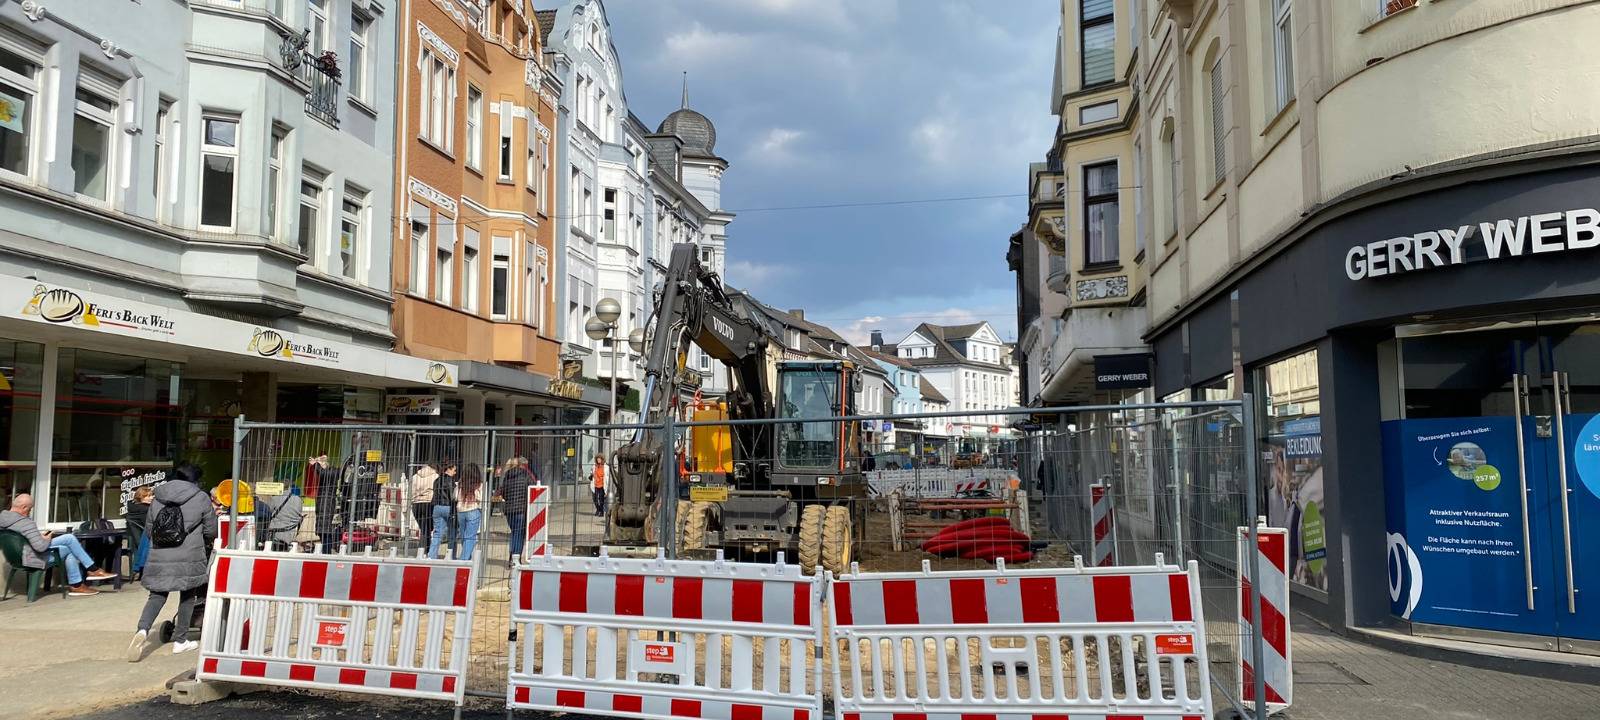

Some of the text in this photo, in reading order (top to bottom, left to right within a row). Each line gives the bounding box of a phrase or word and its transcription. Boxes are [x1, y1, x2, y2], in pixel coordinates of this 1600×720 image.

[1345, 208, 1600, 281] GERRY WEB
[123, 309, 149, 326] BACK
[150, 314, 175, 329] WELT
[713, 316, 733, 340] VOLVO
[1097, 373, 1148, 382] GERRY WEBER
[1417, 433, 1451, 442] Überzeugen
[1475, 474, 1488, 482] 257
[1429, 509, 1509, 518] Attraktiver Verkaufsraum
[1435, 518, 1502, 527] inklusive Nutzfläche.
[1440, 536, 1460, 544] Fläche
[1422, 545, 1455, 553] Wünschen
[1456, 547, 1489, 555] umgebaut
[325, 625, 338, 634] step
[646, 647, 660, 656] step
